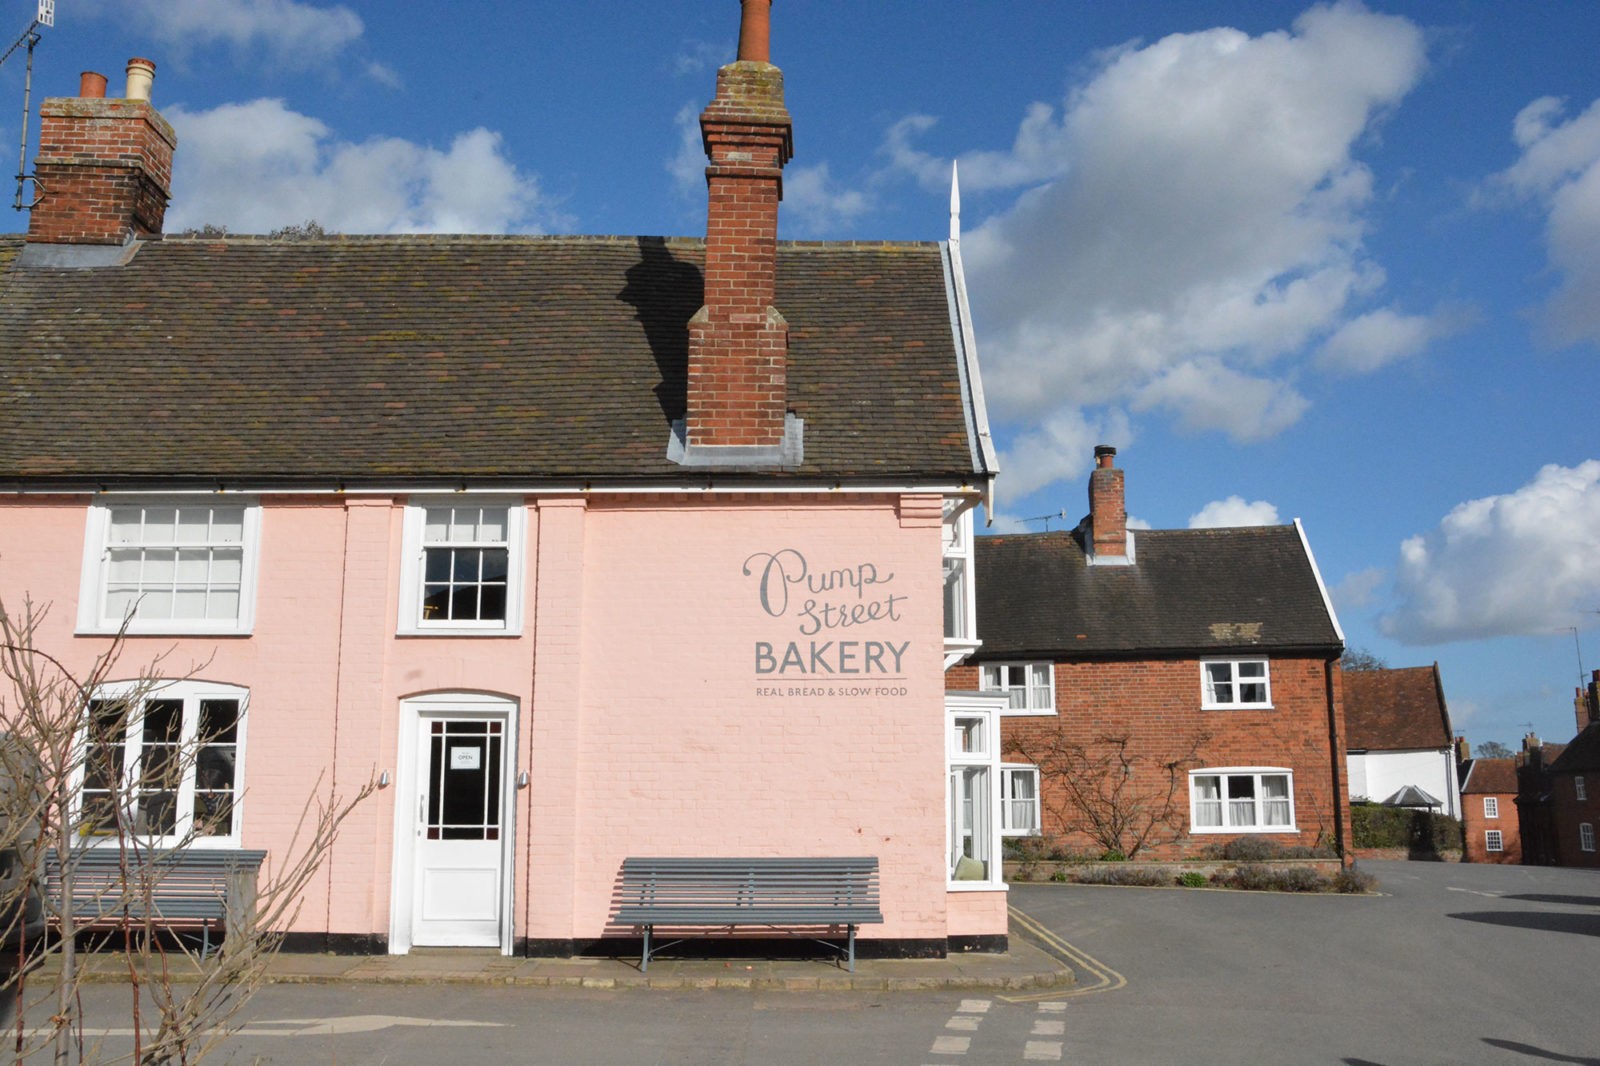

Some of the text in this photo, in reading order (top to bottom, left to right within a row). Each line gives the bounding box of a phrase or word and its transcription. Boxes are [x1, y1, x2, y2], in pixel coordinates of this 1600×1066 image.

[742, 548, 894, 618] Pump
[797, 594, 908, 636] Street
[755, 641, 911, 674] BAKERY
[756, 687, 908, 697] REAL BREAD & SLOW FOOD
